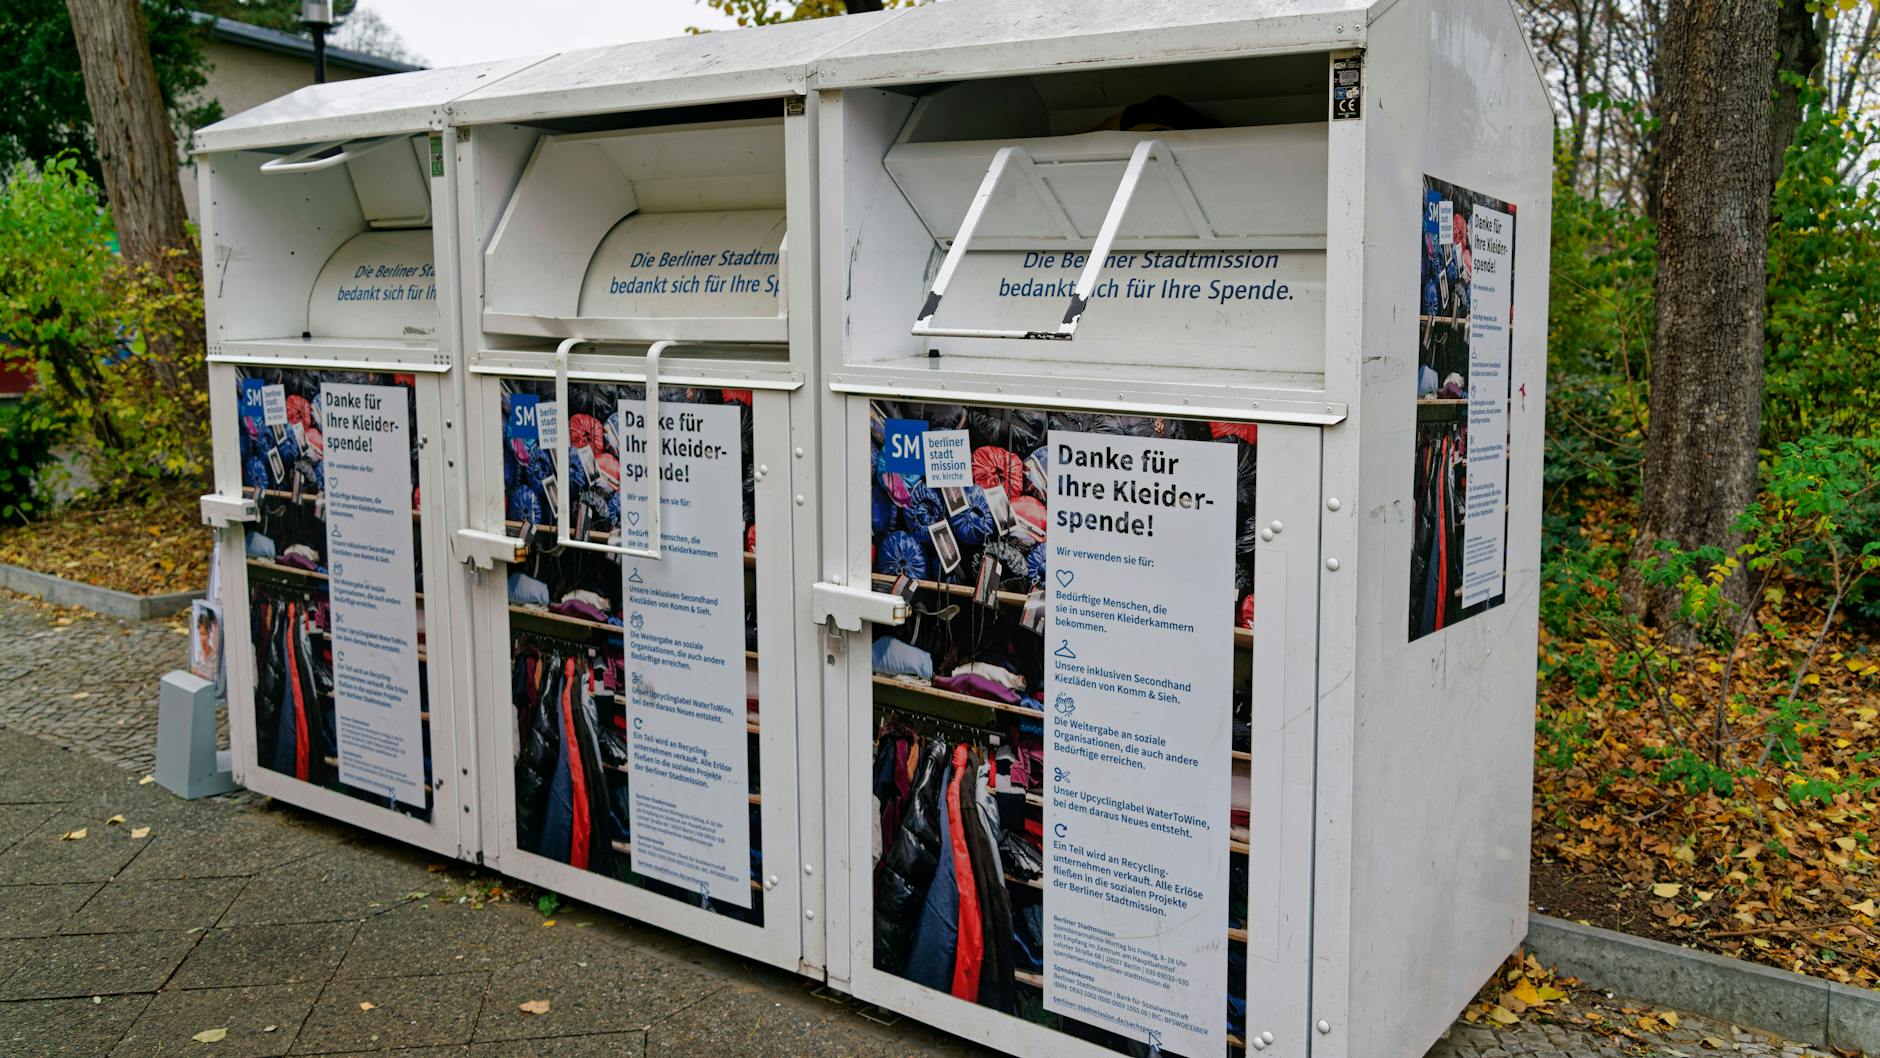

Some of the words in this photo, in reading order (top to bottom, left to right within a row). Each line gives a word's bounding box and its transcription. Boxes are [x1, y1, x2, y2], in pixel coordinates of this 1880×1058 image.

[1428, 202, 1439, 222] SM
[1475, 214, 1493, 233] Danke
[1494, 218, 1502, 234] für
[1475, 234, 1486, 250] Ihre
[1487, 236, 1508, 256] Kleider-
[631, 252, 654, 268] Die
[659, 250, 717, 268] Berliner
[1024, 251, 1055, 268] Die
[1061, 252, 1137, 268] Bener
[1141, 250, 1279, 269] Stadtmission
[1474, 258, 1496, 274] spende!
[354, 265, 374, 278] Die
[376, 264, 418, 278] Berliner
[338, 285, 381, 301] bedankt
[383, 285, 404, 301] sich
[408, 284, 424, 300] für
[610, 276, 668, 294] bedankt
[671, 275, 700, 294] sich
[704, 275, 727, 293] für
[730, 274, 760, 293] Ihre
[999, 278, 1077, 297] bedankt
[1126, 278, 1156, 298] für
[1162, 279, 1201, 299] Ihre
[1208, 280, 1294, 305] Spende.
[246, 389, 262, 406] SM
[326, 392, 362, 409] Danke
[365, 393, 383, 411] für
[327, 412, 350, 430] Ihre
[353, 414, 400, 433] Kleider-
[515, 406, 535, 427] SM
[626, 411, 675, 432] Dake
[680, 413, 705, 433] für
[328, 436, 374, 453] spende!
[662, 438, 728, 460] Kleider-
[892, 434, 920, 460] SM
[929, 438, 964, 448] berliner
[930, 449, 954, 460] stadt
[1059, 444, 1134, 472] Danke
[1141, 449, 1180, 475] für
[931, 461, 966, 471] mission
[942, 472, 963, 480] kirche
[627, 493, 638, 502] Wir
[671, 498, 680, 507] sie
[680, 498, 692, 508] für:
[1058, 474, 1105, 500] Ihre
[1113, 480, 1214, 510] Kleider-
[1057, 510, 1154, 538] spende!
[691, 536, 702, 546] die
[668, 545, 719, 559] Kleiderkammern
[1056, 546, 1072, 557] Wir
[1072, 550, 1122, 564] verwenden
[1123, 555, 1137, 566] sie
[1138, 556, 1154, 568] für:
[629, 585, 650, 596] Unsere
[650, 588, 680, 601] inklusiven
[681, 593, 719, 607] Secondhand
[630, 596, 658, 608] Kiezläden
[658, 602, 670, 610] von
[671, 603, 690, 613] Komm
[691, 606, 696, 614] &
[697, 607, 712, 617] Sieh.
[1056, 590, 1102, 607] Bedürftige
[1103, 597, 1151, 615] Menschen,
[1152, 604, 1168, 615] die
[1055, 616, 1107, 633] bekommen.
[1056, 603, 1068, 614] sie
[1069, 605, 1078, 615] in
[1079, 609, 1115, 621] unseren
[1117, 613, 1194, 633] Kleiderkammern
[631, 631, 640, 640] Die
[641, 633, 674, 646] Weitergabe
[674, 640, 683, 648] an
[683, 642, 704, 652] soziale
[631, 642, 677, 659] Organisationen,
[678, 650, 688, 659] die
[688, 653, 703, 662] auch
[704, 656, 726, 666] andere
[631, 652, 661, 666] Bedürftige
[662, 660, 692, 671] erreichen.
[1055, 660, 1085, 674] Unsere
[1086, 665, 1132, 682] inklusiven
[1134, 673, 1192, 693] Secondhand
[1054, 673, 1097, 689] Kiezläden
[1099, 682, 1115, 693] von
[1117, 684, 1147, 698] Komm
[1148, 690, 1156, 700] &
[1157, 692, 1181, 705] Sieh.
[693, 700, 735, 717] WaterToWine,
[1054, 716, 1068, 728] Die
[1070, 719, 1120, 738] Weitergabe
[1121, 731, 1133, 741] an
[1134, 734, 1166, 747] soziale
[678, 743, 710, 758] Recycling-
[1054, 729, 1124, 754] Organisationen,
[1125, 744, 1140, 755] die
[1141, 749, 1164, 760] auch
[1166, 754, 1199, 767] andere
[1054, 742, 1099, 761] Bedürftige
[1100, 754, 1146, 770] erreichen.
[1053, 797, 1067, 809] bei
[1068, 801, 1088, 814] dem
[1089, 806, 1120, 822] daraus
[1121, 814, 1149, 829] Neues
[1150, 822, 1193, 839] entsteht.
[1054, 785, 1079, 799] Unser
[1080, 791, 1145, 814] Upcyclinglabel
[1146, 806, 1210, 831] WaterToWine,
[1053, 840, 1067, 852] Ein
[1068, 844, 1084, 856] Teil
[1086, 850, 1106, 862] wird
[1108, 856, 1120, 865] an
[1121, 857, 1169, 879] Recycling-
[1053, 854, 1112, 876] unternehmen
[1113, 870, 1154, 887] verkauft.
[1155, 880, 1173, 892] Alle
[1175, 884, 1204, 900] Erlöse
[1053, 865, 1083, 881] fließen
[1084, 873, 1093, 884] in
[1094, 877, 1109, 888] die
[1110, 882, 1147, 899] sozialen
[1149, 890, 1188, 909] Projekte
[1053, 878, 1068, 890] der
[1069, 882, 1104, 900] Berliner
[1105, 892, 1167, 917] Stadtmission.
[1053, 914, 1076, 927] Berliner
[1077, 921, 1116, 939] Stadtmission
